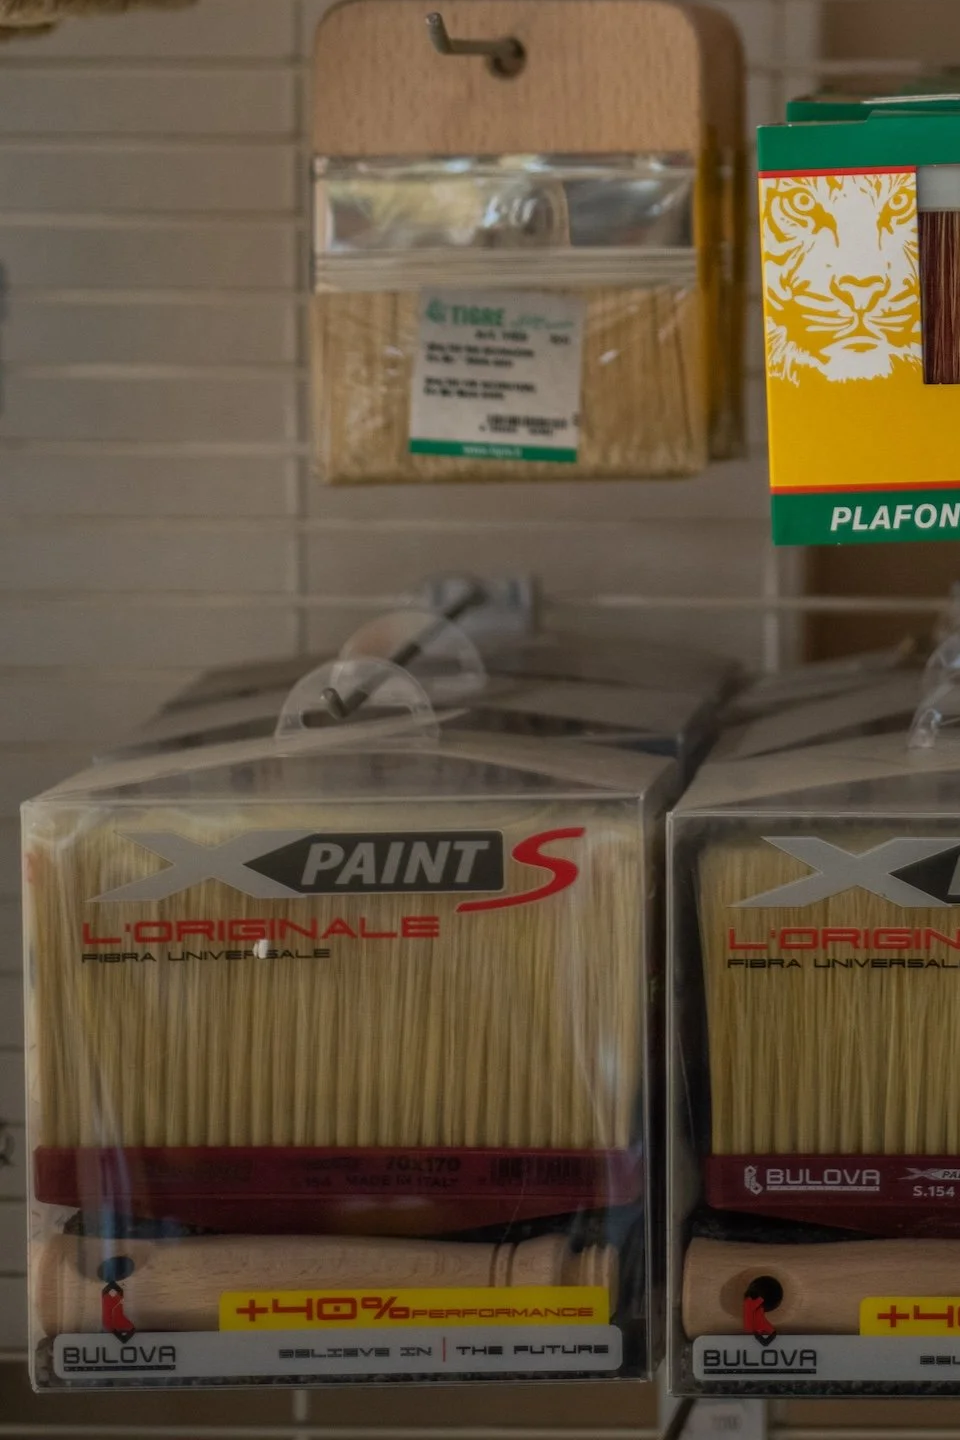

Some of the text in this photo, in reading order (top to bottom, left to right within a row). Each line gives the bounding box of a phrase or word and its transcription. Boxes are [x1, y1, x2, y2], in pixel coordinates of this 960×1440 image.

[300, 840, 489, 886] PAINT
[82, 915, 441, 946] L'ORIGINALE
[726, 957, 802, 970] FIBRA
[766, 1168, 881, 1187] BULOVA
[913, 1185, 955, 1197] S.154
[411, 1306, 595, 1319] PERFORMANCE
[63, 1345, 177, 1366] BULOVA
[400, 1346, 433, 1358] IN
[456, 1345, 504, 1355] THE
[512, 1344, 610, 1355] FUTURE
[702, 1348, 818, 1369] BULOVA
